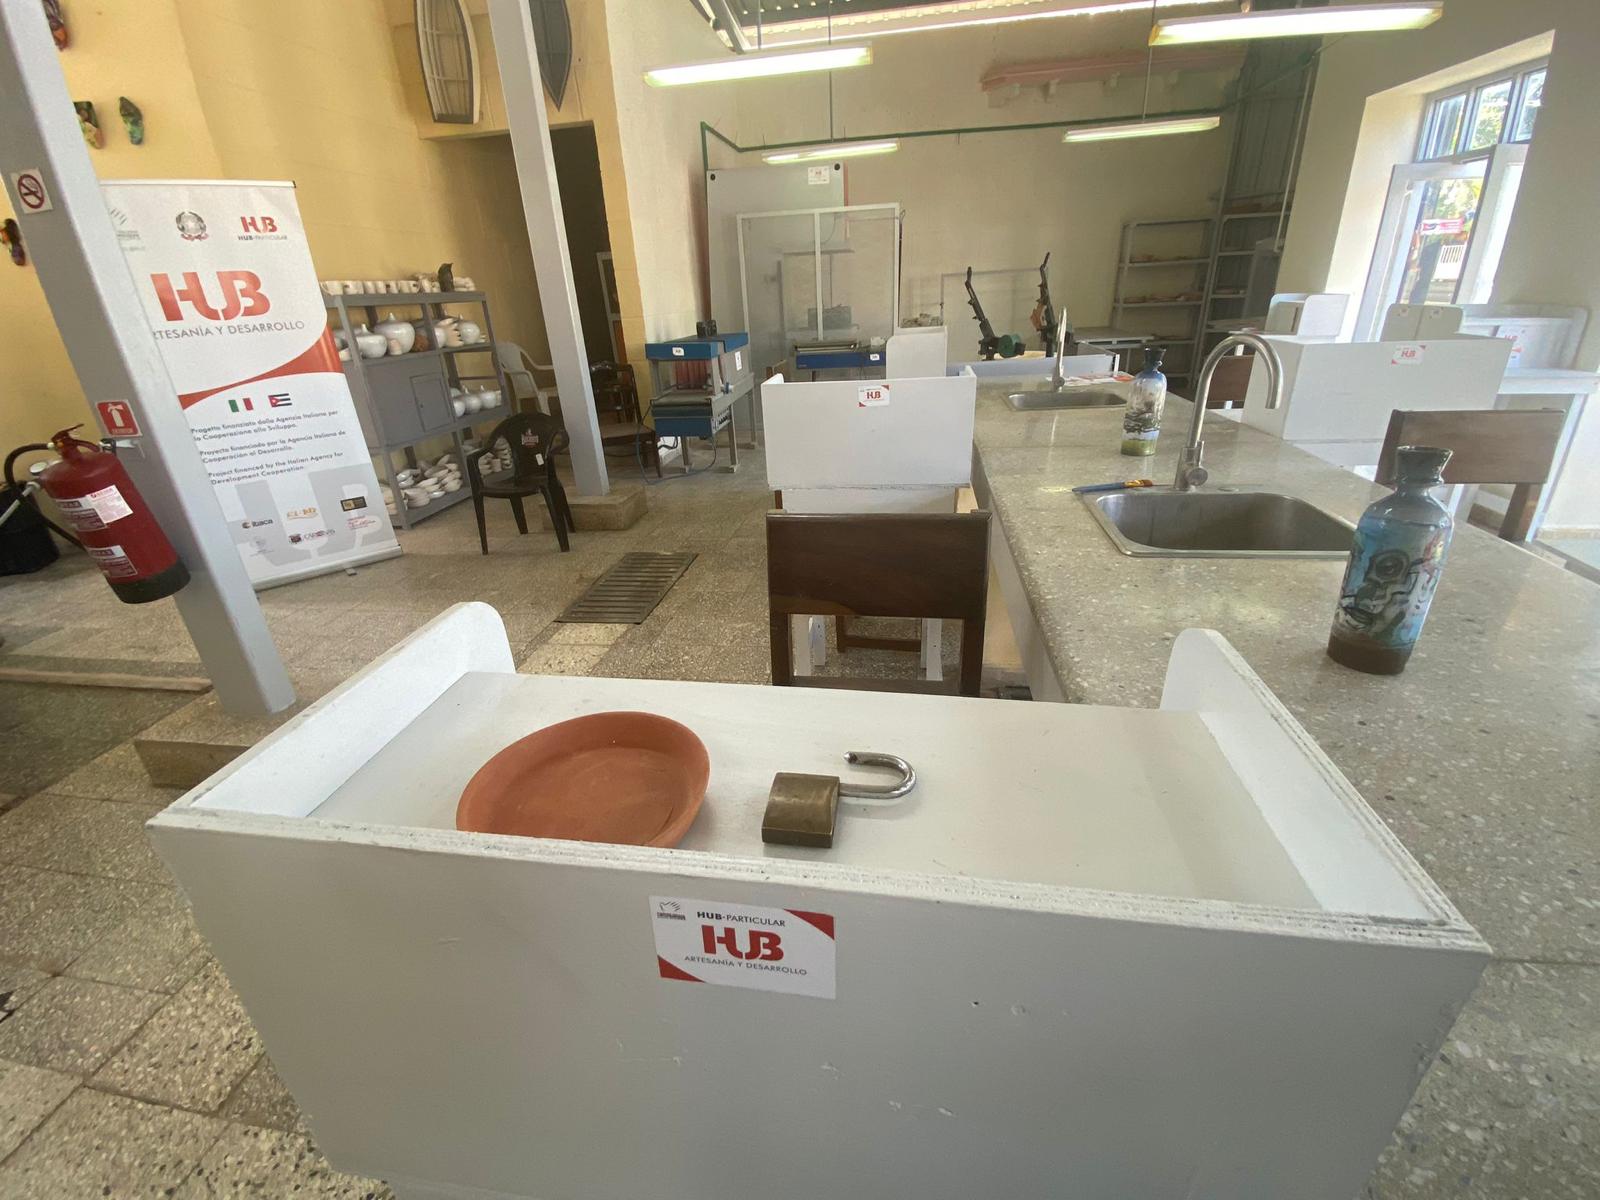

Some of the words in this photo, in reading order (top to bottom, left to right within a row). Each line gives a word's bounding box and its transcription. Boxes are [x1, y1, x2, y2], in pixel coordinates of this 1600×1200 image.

[240, 216, 278, 233] HUB
[149, 270, 271, 322] HUB
[151, 325, 214, 341] RTESANÍA
[214, 325, 223, 335] Y
[227, 320, 306, 336] DESARROLLO
[866, 391, 881, 399] HUB
[190, 425, 221, 433] Progetto
[222, 420, 257, 429] finanziato
[276, 414, 302, 423] Agenzia
[202, 429, 253, 441] Cooperazione
[199, 447, 230, 457] Proyecto
[230, 441, 266, 451] financiado
[288, 435, 313, 443] Agencia
[208, 470, 234, 478] Project
[234, 464, 264, 473] financed
[310, 453, 333, 462] Agency
[210, 472, 260, 485] Development
[260, 465, 305, 477] Cooperation
[696, 911, 786, 928] HUB-PARTICULAR
[701, 924, 785, 962] HUB
[684, 955, 735, 968] ARTESANÍA
[745, 962, 808, 976] DESARROLLO
